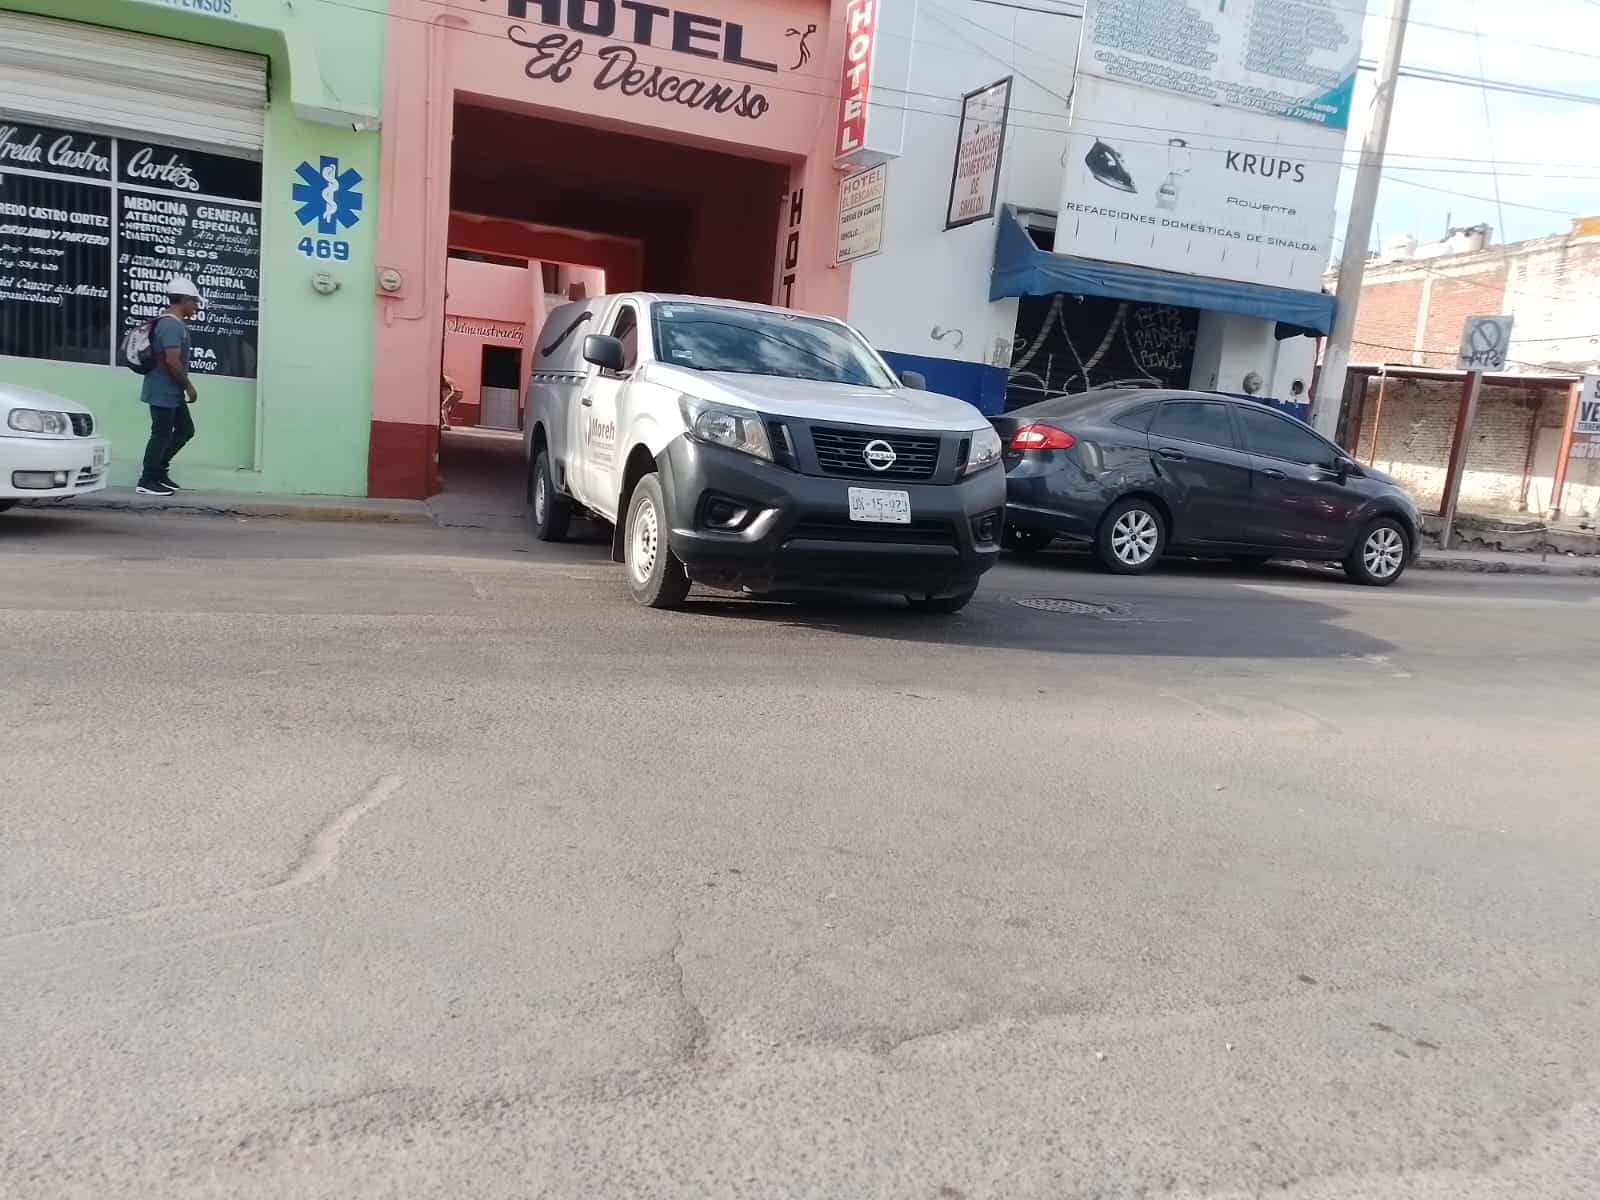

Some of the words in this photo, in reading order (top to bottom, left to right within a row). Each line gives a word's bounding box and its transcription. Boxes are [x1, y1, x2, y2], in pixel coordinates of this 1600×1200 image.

[508, 0, 778, 73] HOTEL
[508, 25, 582, 83] El
[593, 45, 770, 120] Descanso
[842, 0, 873, 151] HOTEL
[48, 136, 109, 173] Castro
[1224, 150, 1305, 184] KRUPS
[28, 206, 68, 222] CASTRO
[69, 212, 109, 228] CORTEZ
[124, 195, 189, 217] MEDICINA
[196, 206, 257, 226] GENERAL
[1226, 196, 1297, 216] Rowenta
[125, 210, 186, 227] ATENCION
[191, 219, 243, 235] ESPECIAL
[1066, 200, 1156, 226] REFACCIONES
[1160, 217, 1241, 240] DOMESTICAS
[1245, 233, 1265, 245] DE
[1266, 236, 1318, 254] SINALOA
[153, 245, 219, 260] OBESOS
[297, 236, 350, 261] 469
[196, 274, 247, 291] GENERAL
